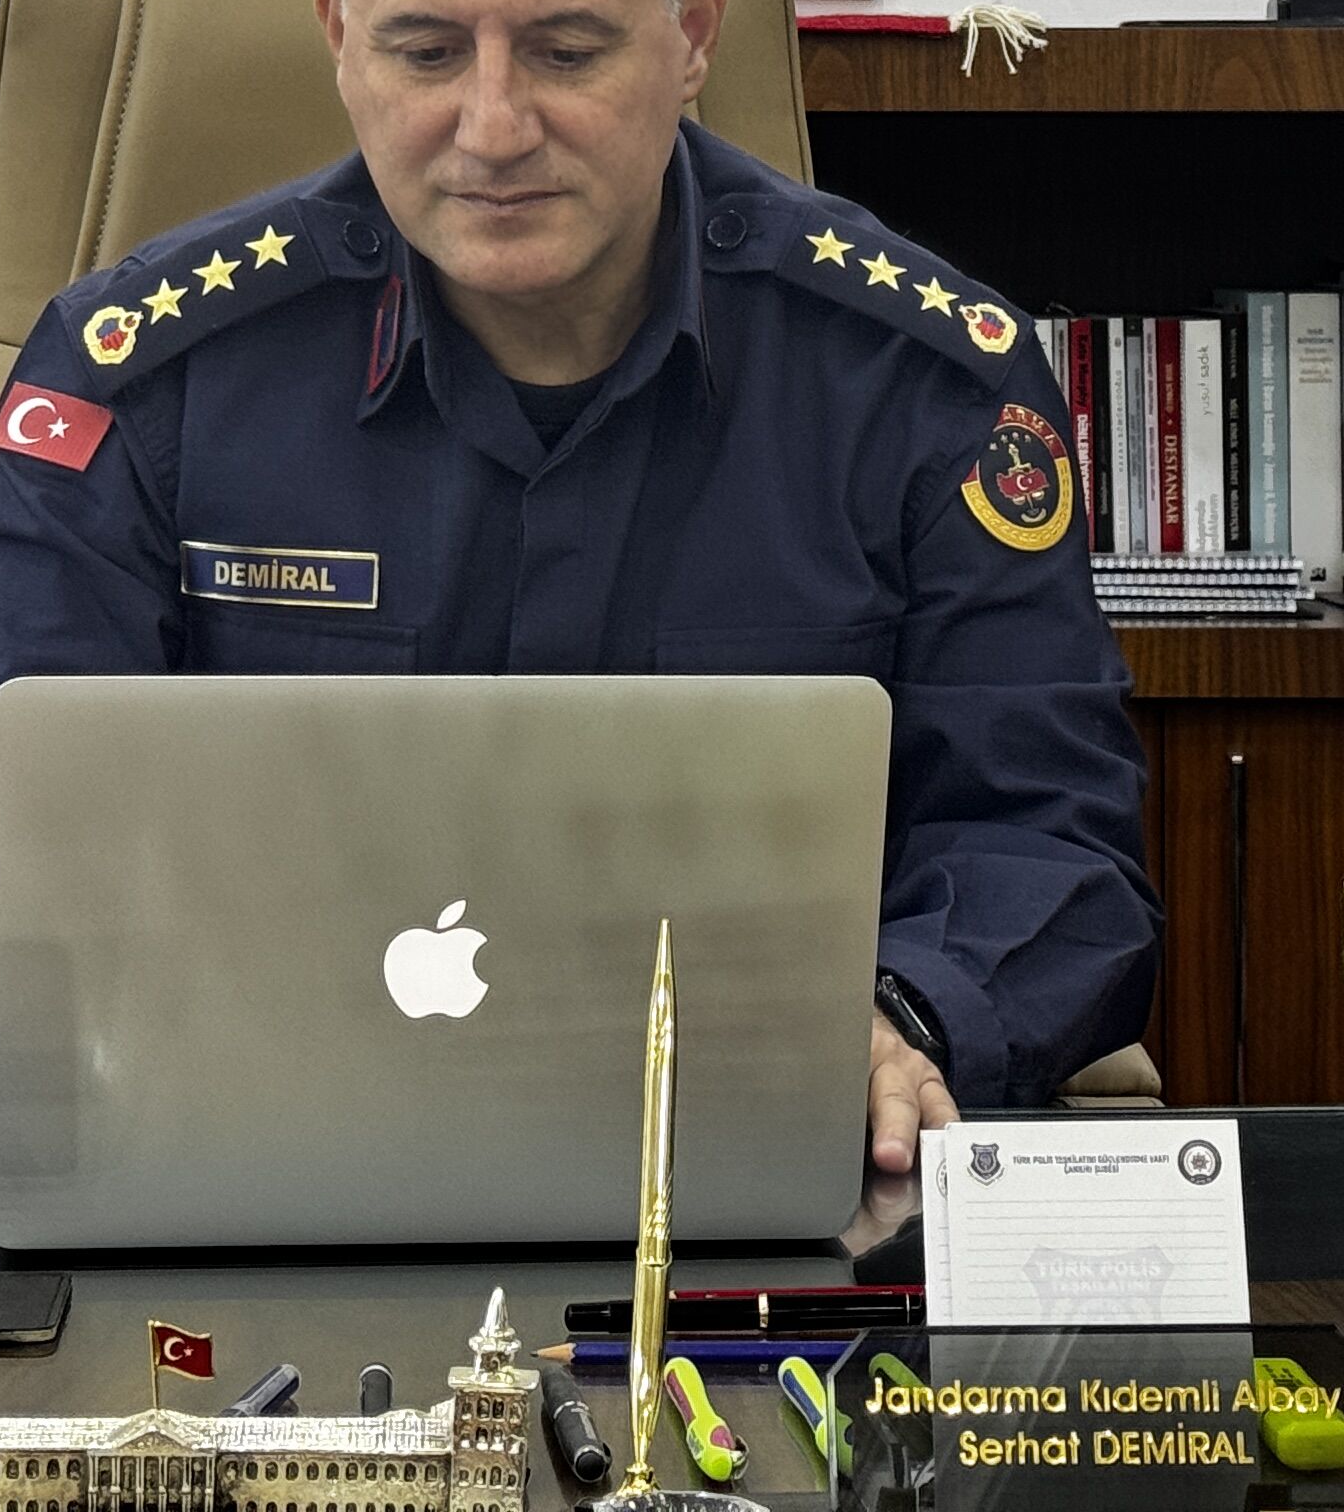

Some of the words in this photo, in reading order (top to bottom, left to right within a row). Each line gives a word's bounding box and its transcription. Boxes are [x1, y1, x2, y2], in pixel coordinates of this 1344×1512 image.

[1164, 434, 1179, 525] DESTANLAR
[214, 558, 337, 593] DEMİRAL
[1012, 1155, 1031, 1165] TÜRK
[865, 1377, 1067, 1415] Jandarma
[1231, 1379, 1342, 1420] Albay
[959, 1429, 1081, 1467] Serhat
[1093, 1422, 1256, 1467] DEMİRAL
